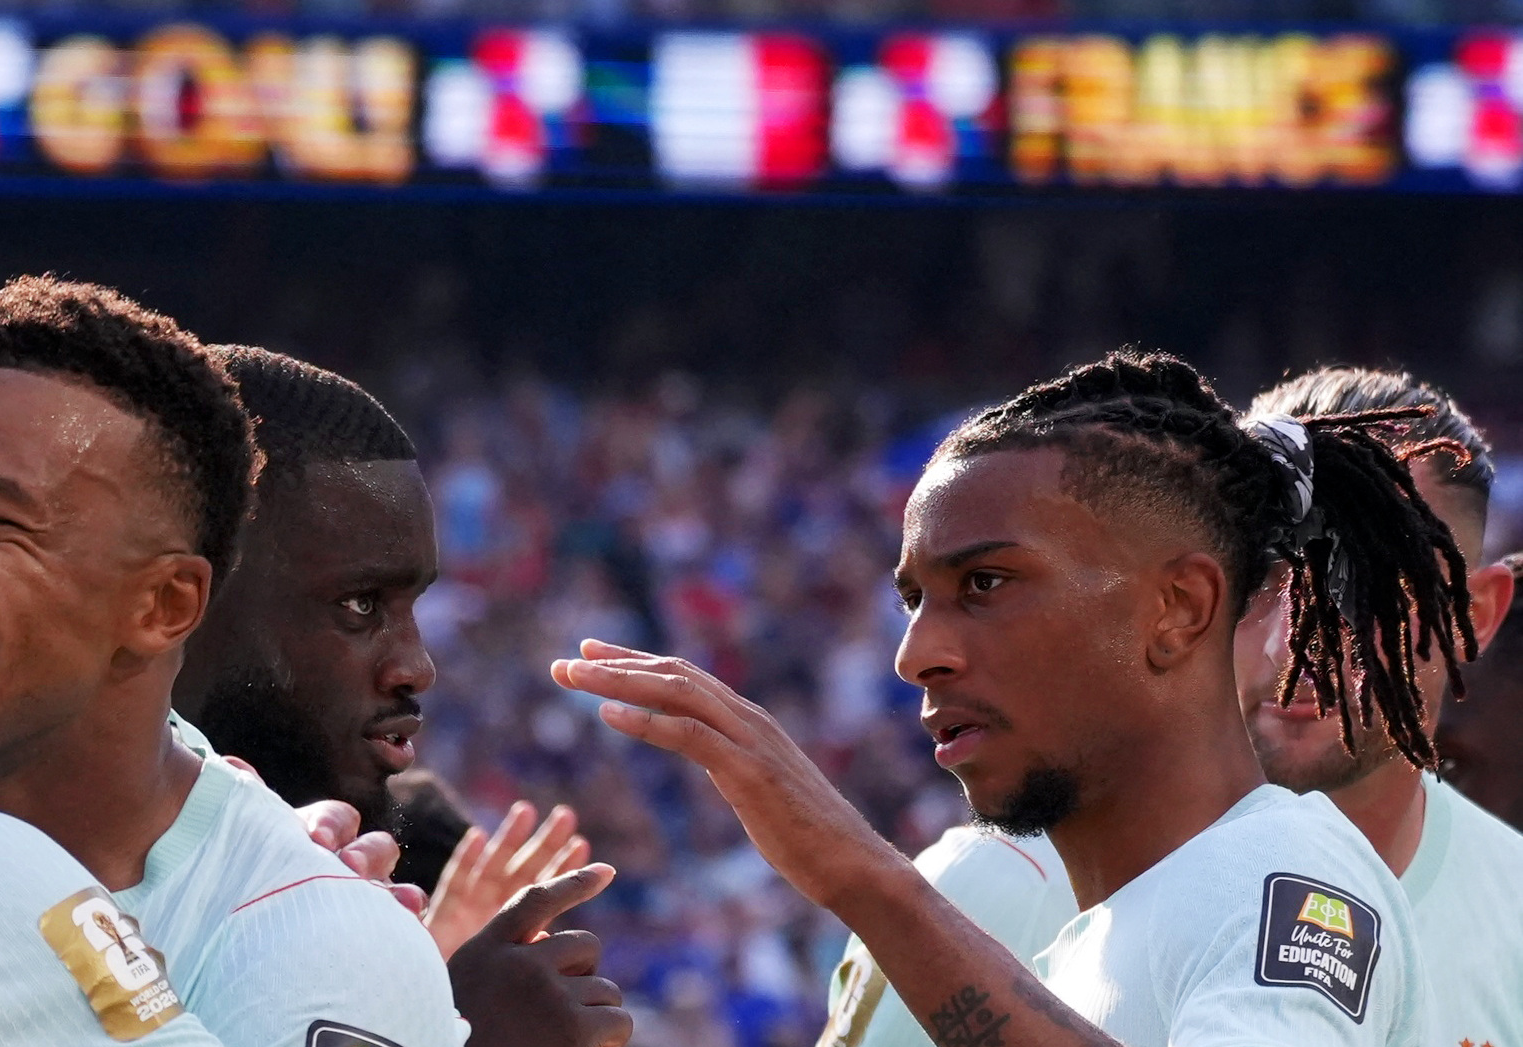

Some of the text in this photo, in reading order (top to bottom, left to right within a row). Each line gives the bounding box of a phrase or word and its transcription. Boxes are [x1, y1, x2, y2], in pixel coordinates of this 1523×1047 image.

[1291, 925, 1353, 959] Unite For
[131, 963, 151, 979] FIFA
[1278, 945, 1358, 990] EDUCATION
[1304, 966, 1333, 988] FIFA
[130, 985, 161, 1007] WORLD
[137, 990, 178, 1022] 2026
